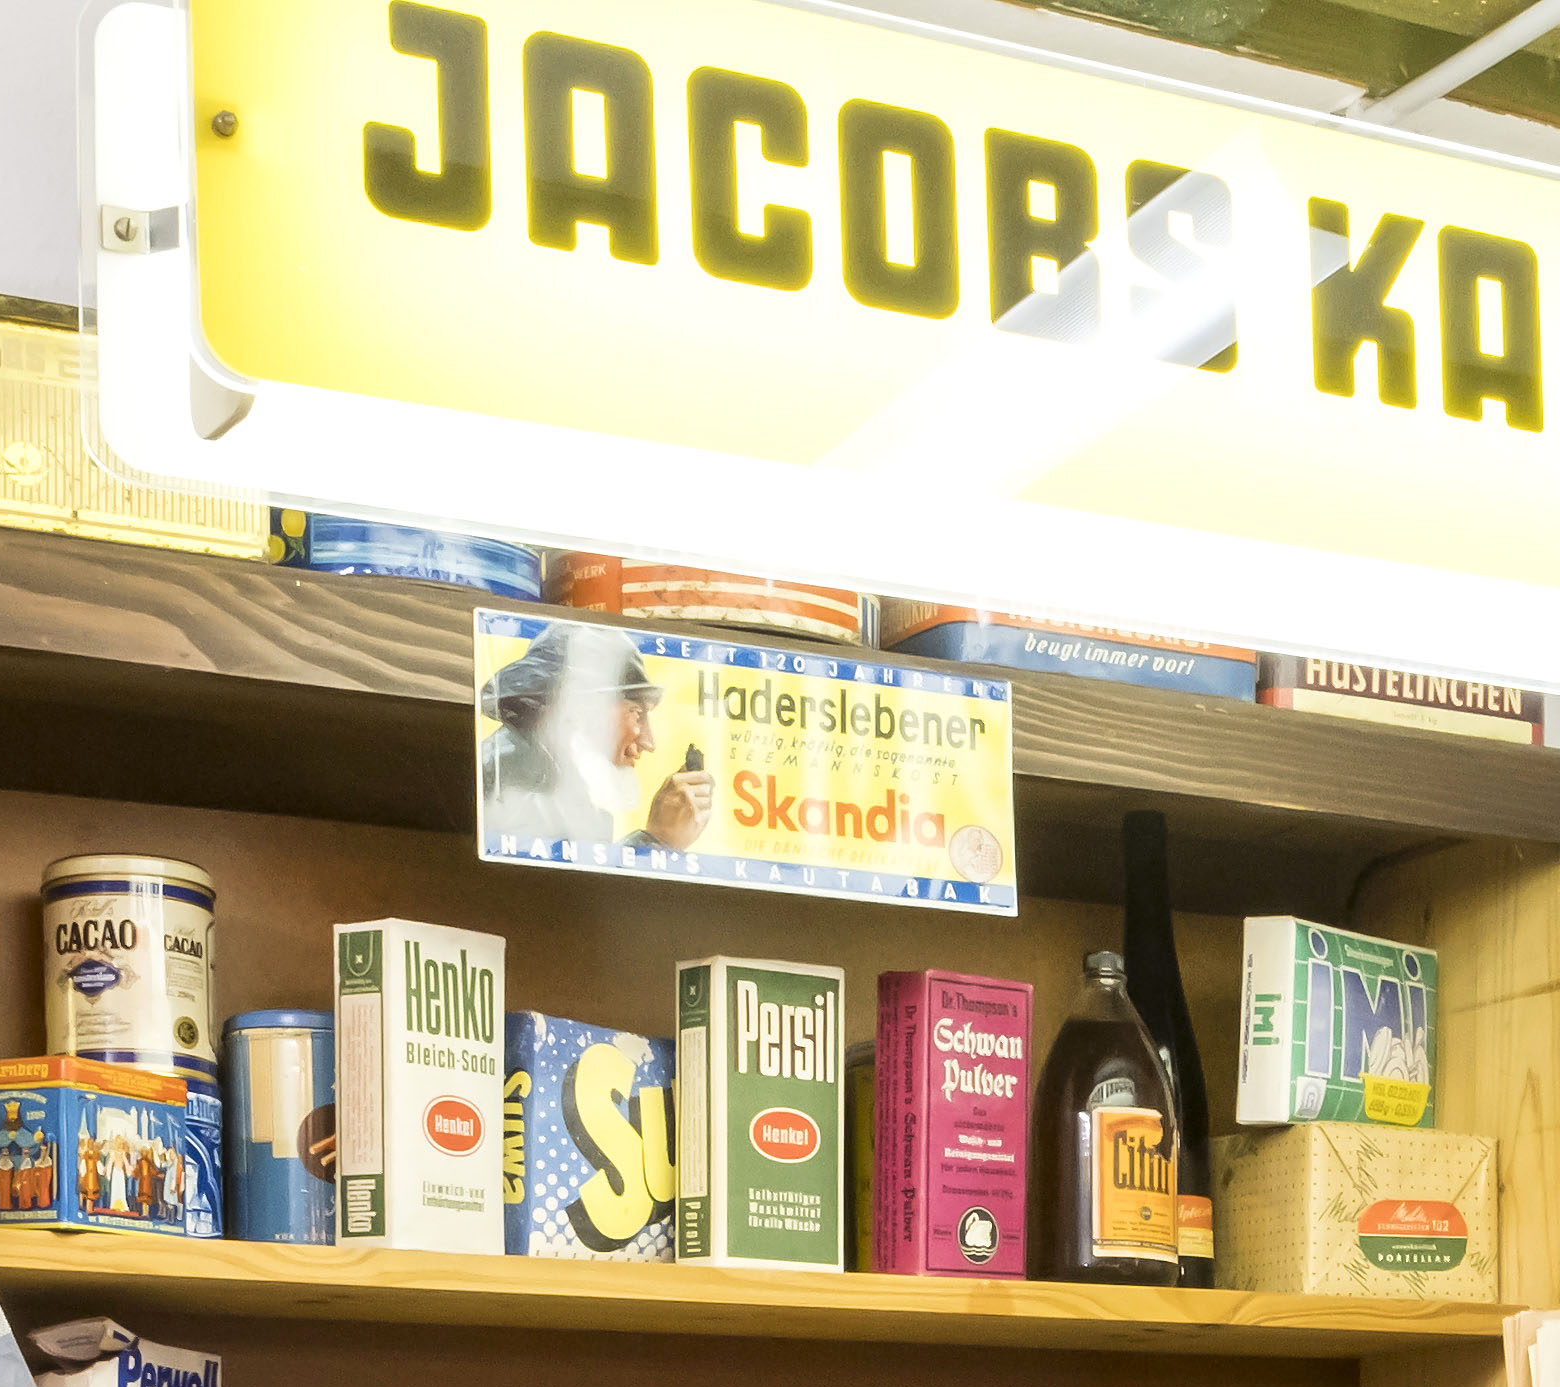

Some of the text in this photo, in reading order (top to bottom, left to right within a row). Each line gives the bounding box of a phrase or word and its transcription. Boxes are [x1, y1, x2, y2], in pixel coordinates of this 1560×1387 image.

[363, 0, 1241, 375] JACOBS
[656, 637, 985, 696] SEIT 120 JAHREN
[1024, 633, 1080, 662] beugt
[1084, 642, 1149, 671] immer
[697, 670, 986, 751] Haderslebener
[733, 770, 946, 848] Skandia
[501, 834, 992, 905] HANSEN'S KAUTABAK
[56, 919, 137, 954] CACAO
[164, 933, 203, 958] CACAO
[405, 939, 495, 1045] Henko
[957, 992, 1018, 1018] Thompson's
[734, 978, 835, 1084] Persil
[933, 1017, 1023, 1060] Schwan
[406, 1042, 496, 1076] Bleich-Soda
[941, 1059, 1018, 1102] Pulver
[434, 1113, 474, 1139] Henkel
[574, 1043, 676, 1241] Su
[762, 1124, 809, 1146] Henkel
[345, 1178, 376, 1234] Henko
